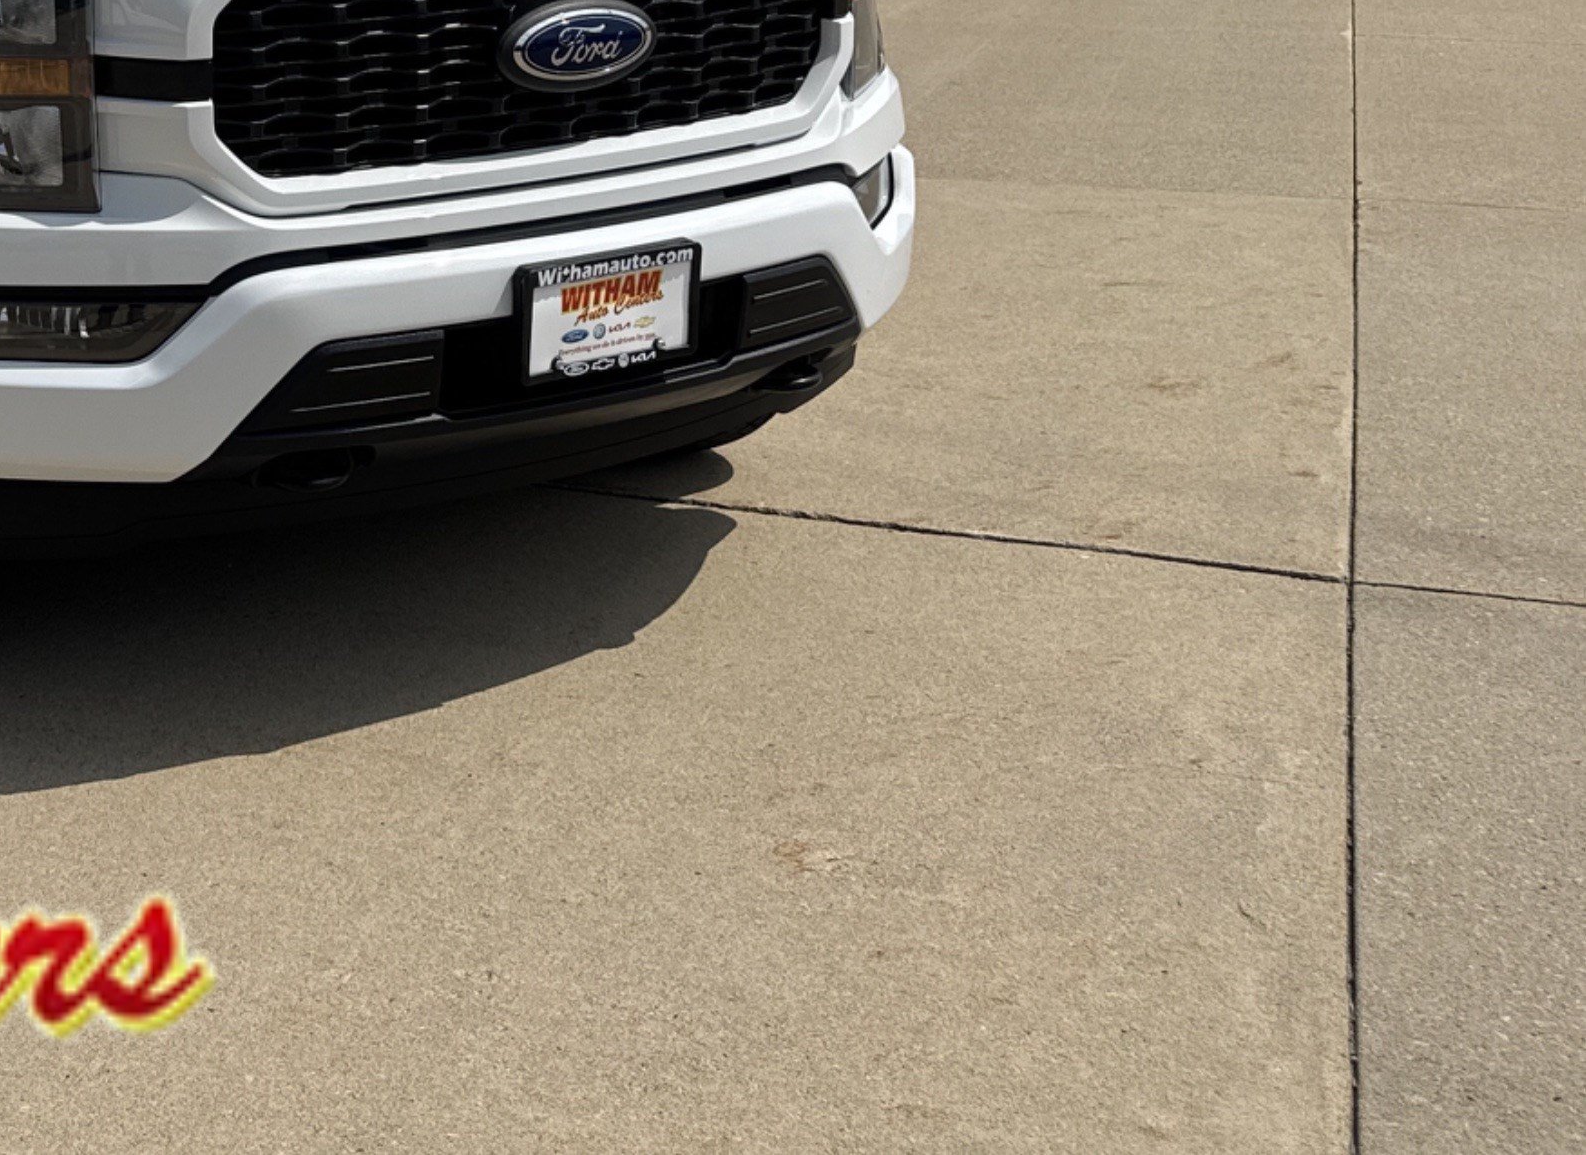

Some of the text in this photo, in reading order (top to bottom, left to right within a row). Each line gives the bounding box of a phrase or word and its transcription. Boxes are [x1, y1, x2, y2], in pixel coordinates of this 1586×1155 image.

[550, 23, 623, 67] Ford
[538, 248, 693, 287] Withamauto.com
[562, 270, 664, 315] WITHAM
[574, 307, 609, 326] Auto
